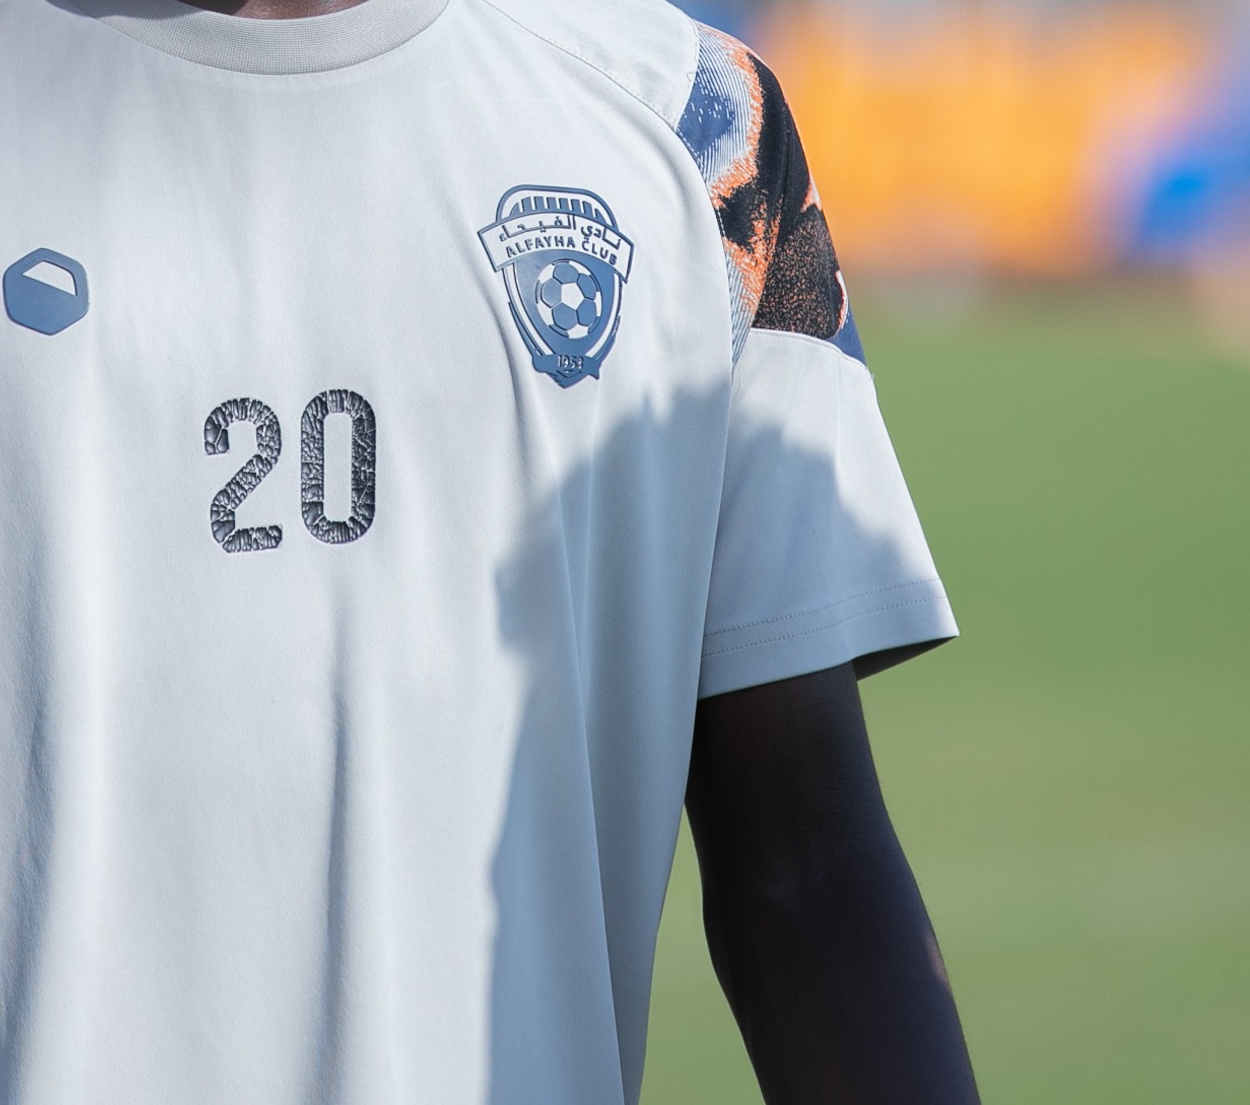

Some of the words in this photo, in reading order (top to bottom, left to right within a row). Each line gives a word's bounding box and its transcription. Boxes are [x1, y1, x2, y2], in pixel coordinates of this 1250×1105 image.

[499, 214, 576, 242] الفيحاء
[581, 225, 621, 250] نادي
[505, 235, 576, 258] ALFAYHA
[582, 240, 618, 266] CLUB
[203, 389, 376, 554] 20
